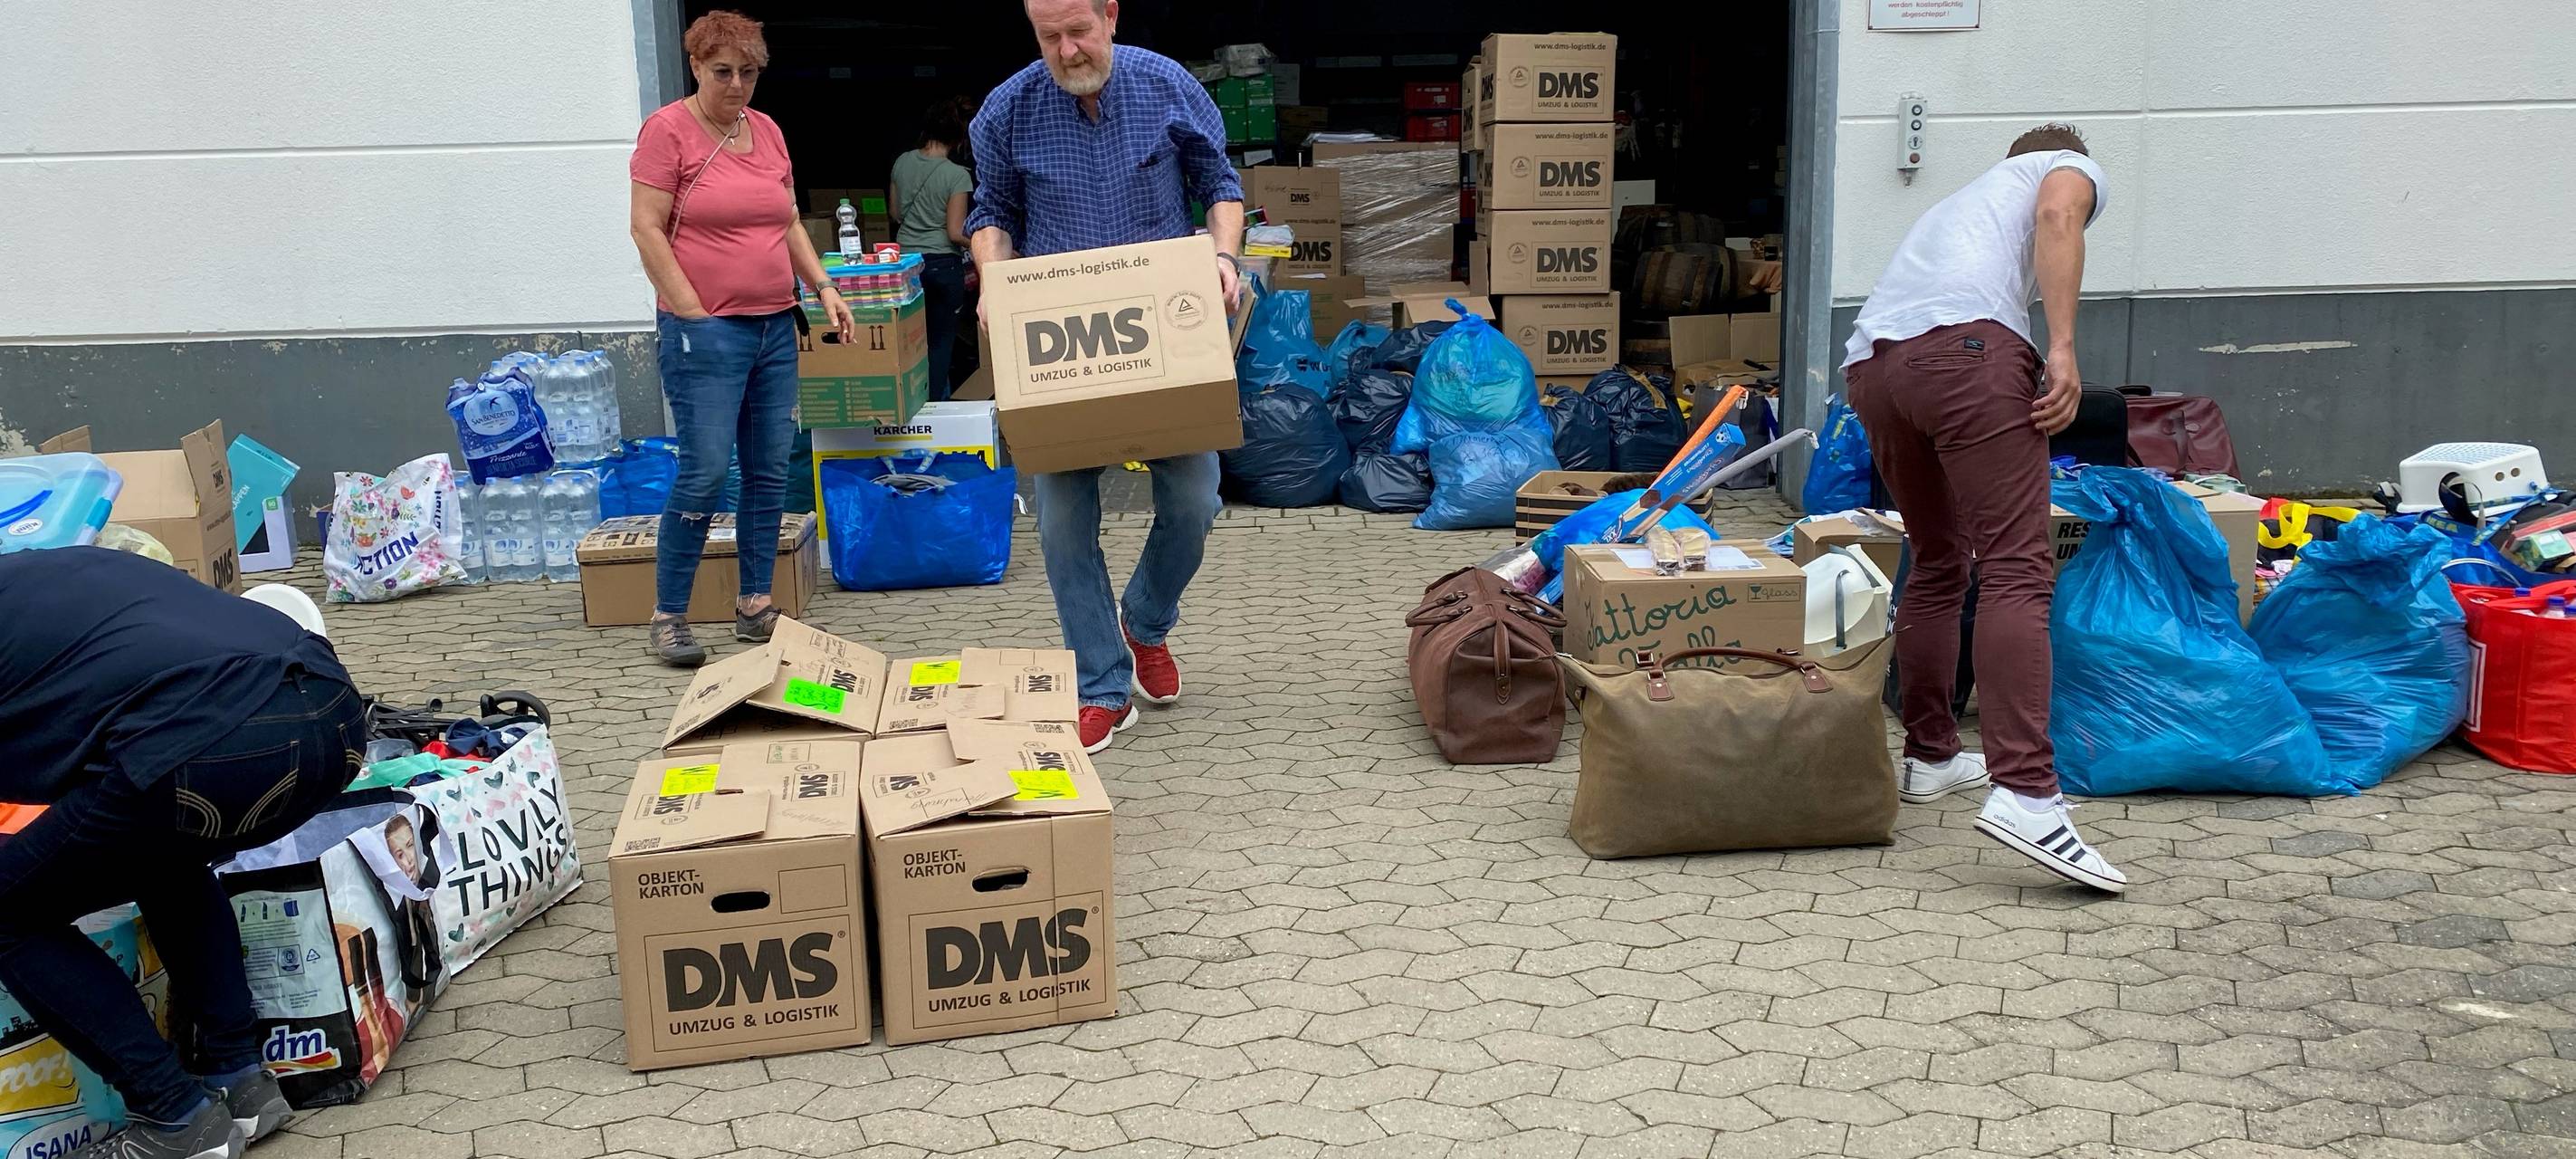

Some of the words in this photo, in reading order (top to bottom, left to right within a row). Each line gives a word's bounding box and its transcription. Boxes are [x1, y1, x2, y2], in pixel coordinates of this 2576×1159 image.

[1916, 0, 1963, 8] kostenpflichtig
[1534, 43, 1607, 52] www.dms-logistik.de
[1539, 72, 1599, 99] DMS
[1534, 132, 1608, 140] www.dms-logistik.de
[1540, 161, 1601, 187] DMS
[1572, 189, 1600, 197] LOGISTIK
[1531, 218, 1605, 226] www.dms-logistik.de
[1007, 256, 1150, 285] www.dms-logistik.de
[1537, 246, 1598, 273] DMS
[1541, 302, 1614, 311] www.dms-logistik.de
[1024, 307, 1150, 367] DMS
[1547, 328, 1608, 355] DMS
[1030, 368, 1077, 383] UMZUG
[1083, 366, 1093, 376] &
[1098, 358, 1152, 374] LOGISTIK
[1760, 588, 1798, 600] glass
[797, 773, 830, 800] DMS
[457, 776, 563, 872] LOVLY
[447, 822, 568, 917] THINGS
[902, 848, 963, 866] OBJEKT-
[904, 861, 967, 879] KARTON
[637, 868, 701, 886] OBJEKT-
[638, 882, 705, 899] KARTON
[925, 907, 1092, 991] DMS
[663, 932, 838, 1013] DMS
[928, 993, 992, 1013] UMZUG
[998, 991, 1013, 1005] &
[1019, 978, 1092, 1002] LOGISTIK
[669, 1016, 736, 1036] UMZUG
[742, 1013, 758, 1028] &
[764, 1003, 840, 1025] LOGISTIK
[265, 1029, 322, 1062] dm
[25, 1124, 91, 1159] ISANA
